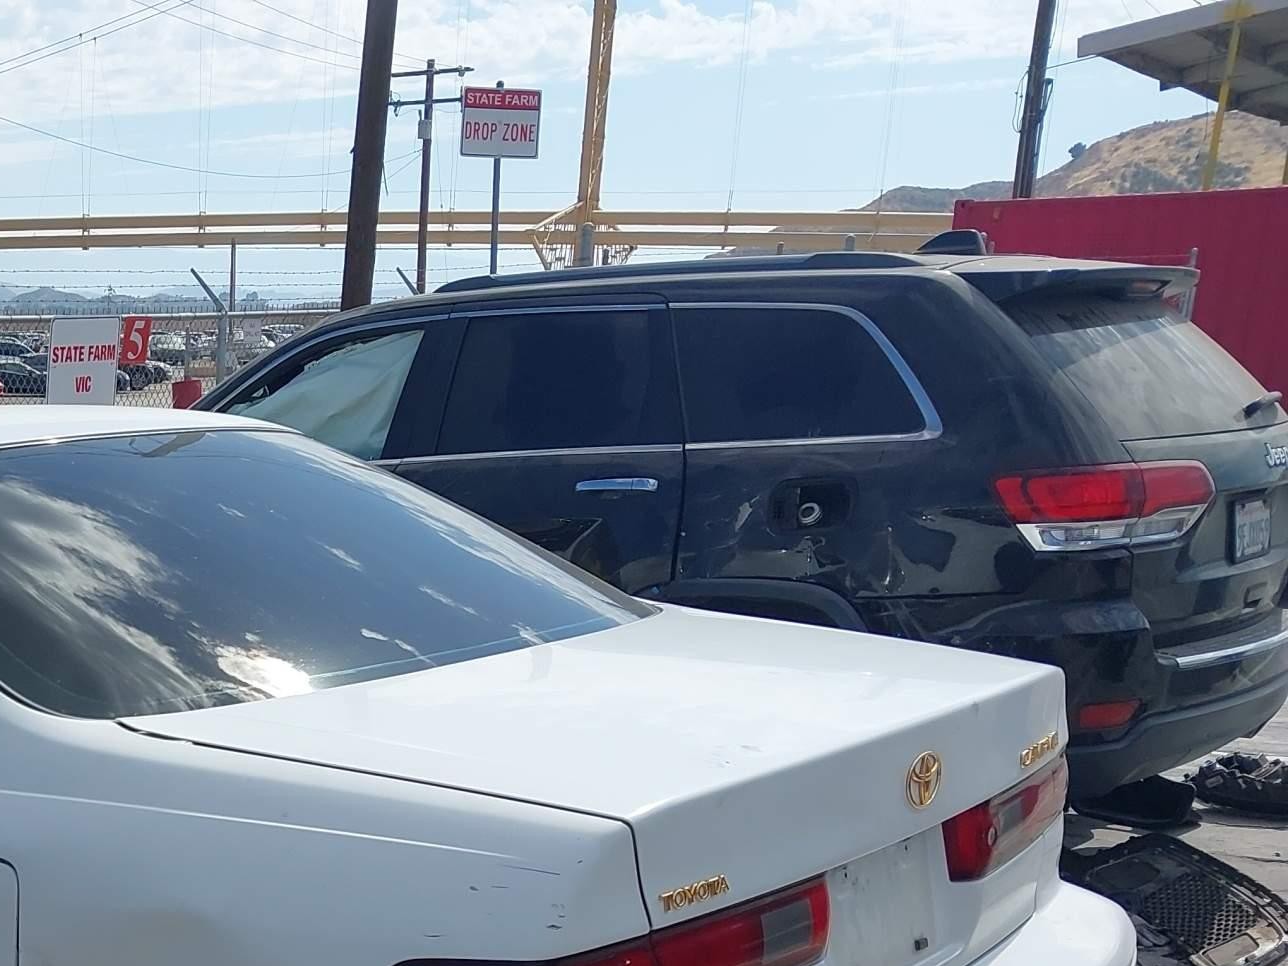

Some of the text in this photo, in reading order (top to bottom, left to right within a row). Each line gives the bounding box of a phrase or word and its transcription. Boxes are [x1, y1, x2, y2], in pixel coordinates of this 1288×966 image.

[467, 92, 538, 107] STATE FARM
[465, 121, 537, 142] DROP ZONE
[127, 320, 145, 360] 5
[52, 344, 116, 364] STATE FARM
[75, 375, 92, 393] VIC
[660, 874, 730, 912] TOYOTA
